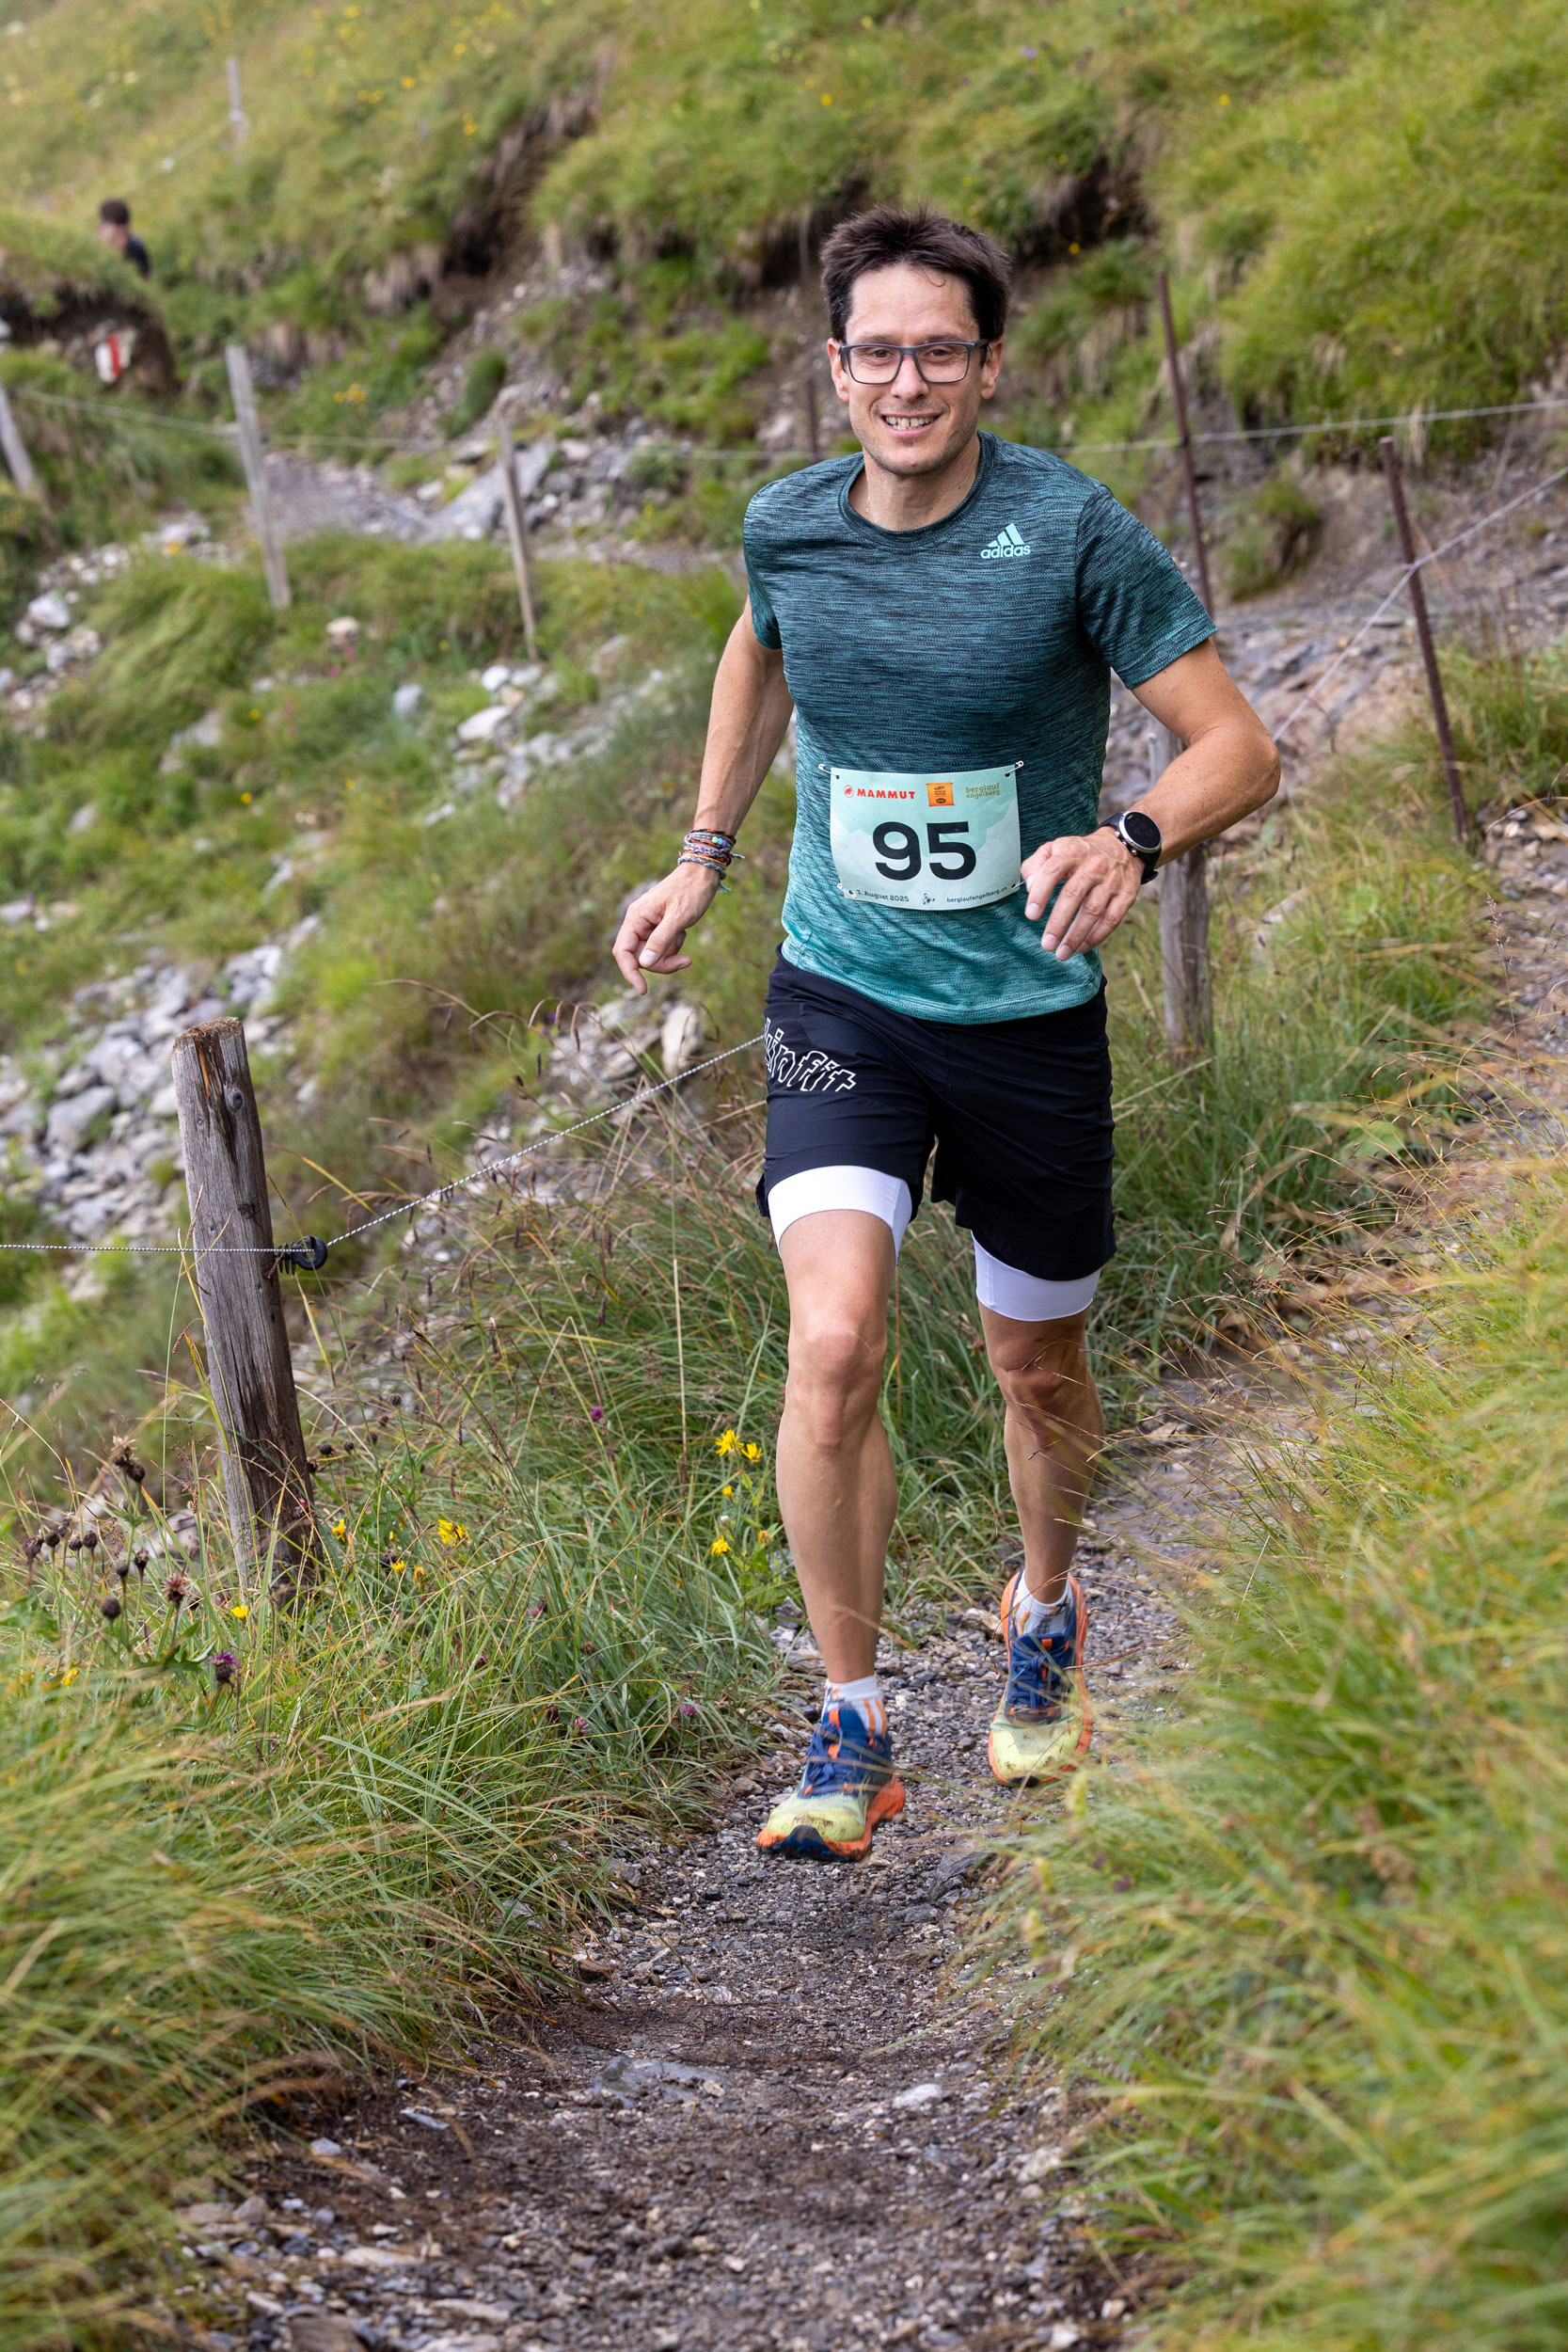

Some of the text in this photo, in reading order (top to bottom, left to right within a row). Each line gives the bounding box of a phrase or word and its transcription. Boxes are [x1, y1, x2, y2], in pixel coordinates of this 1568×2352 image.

[980, 545, 1031, 559] adidas
[857, 788, 915, 799] MAMMUT
[965, 783, 1000, 793] berglauf
[966, 789, 1001, 799] engelberg
[872, 821, 976, 881] 95
[863, 890, 889, 900] August
[946, 886, 1007, 903] berglaufengelberg.ch
